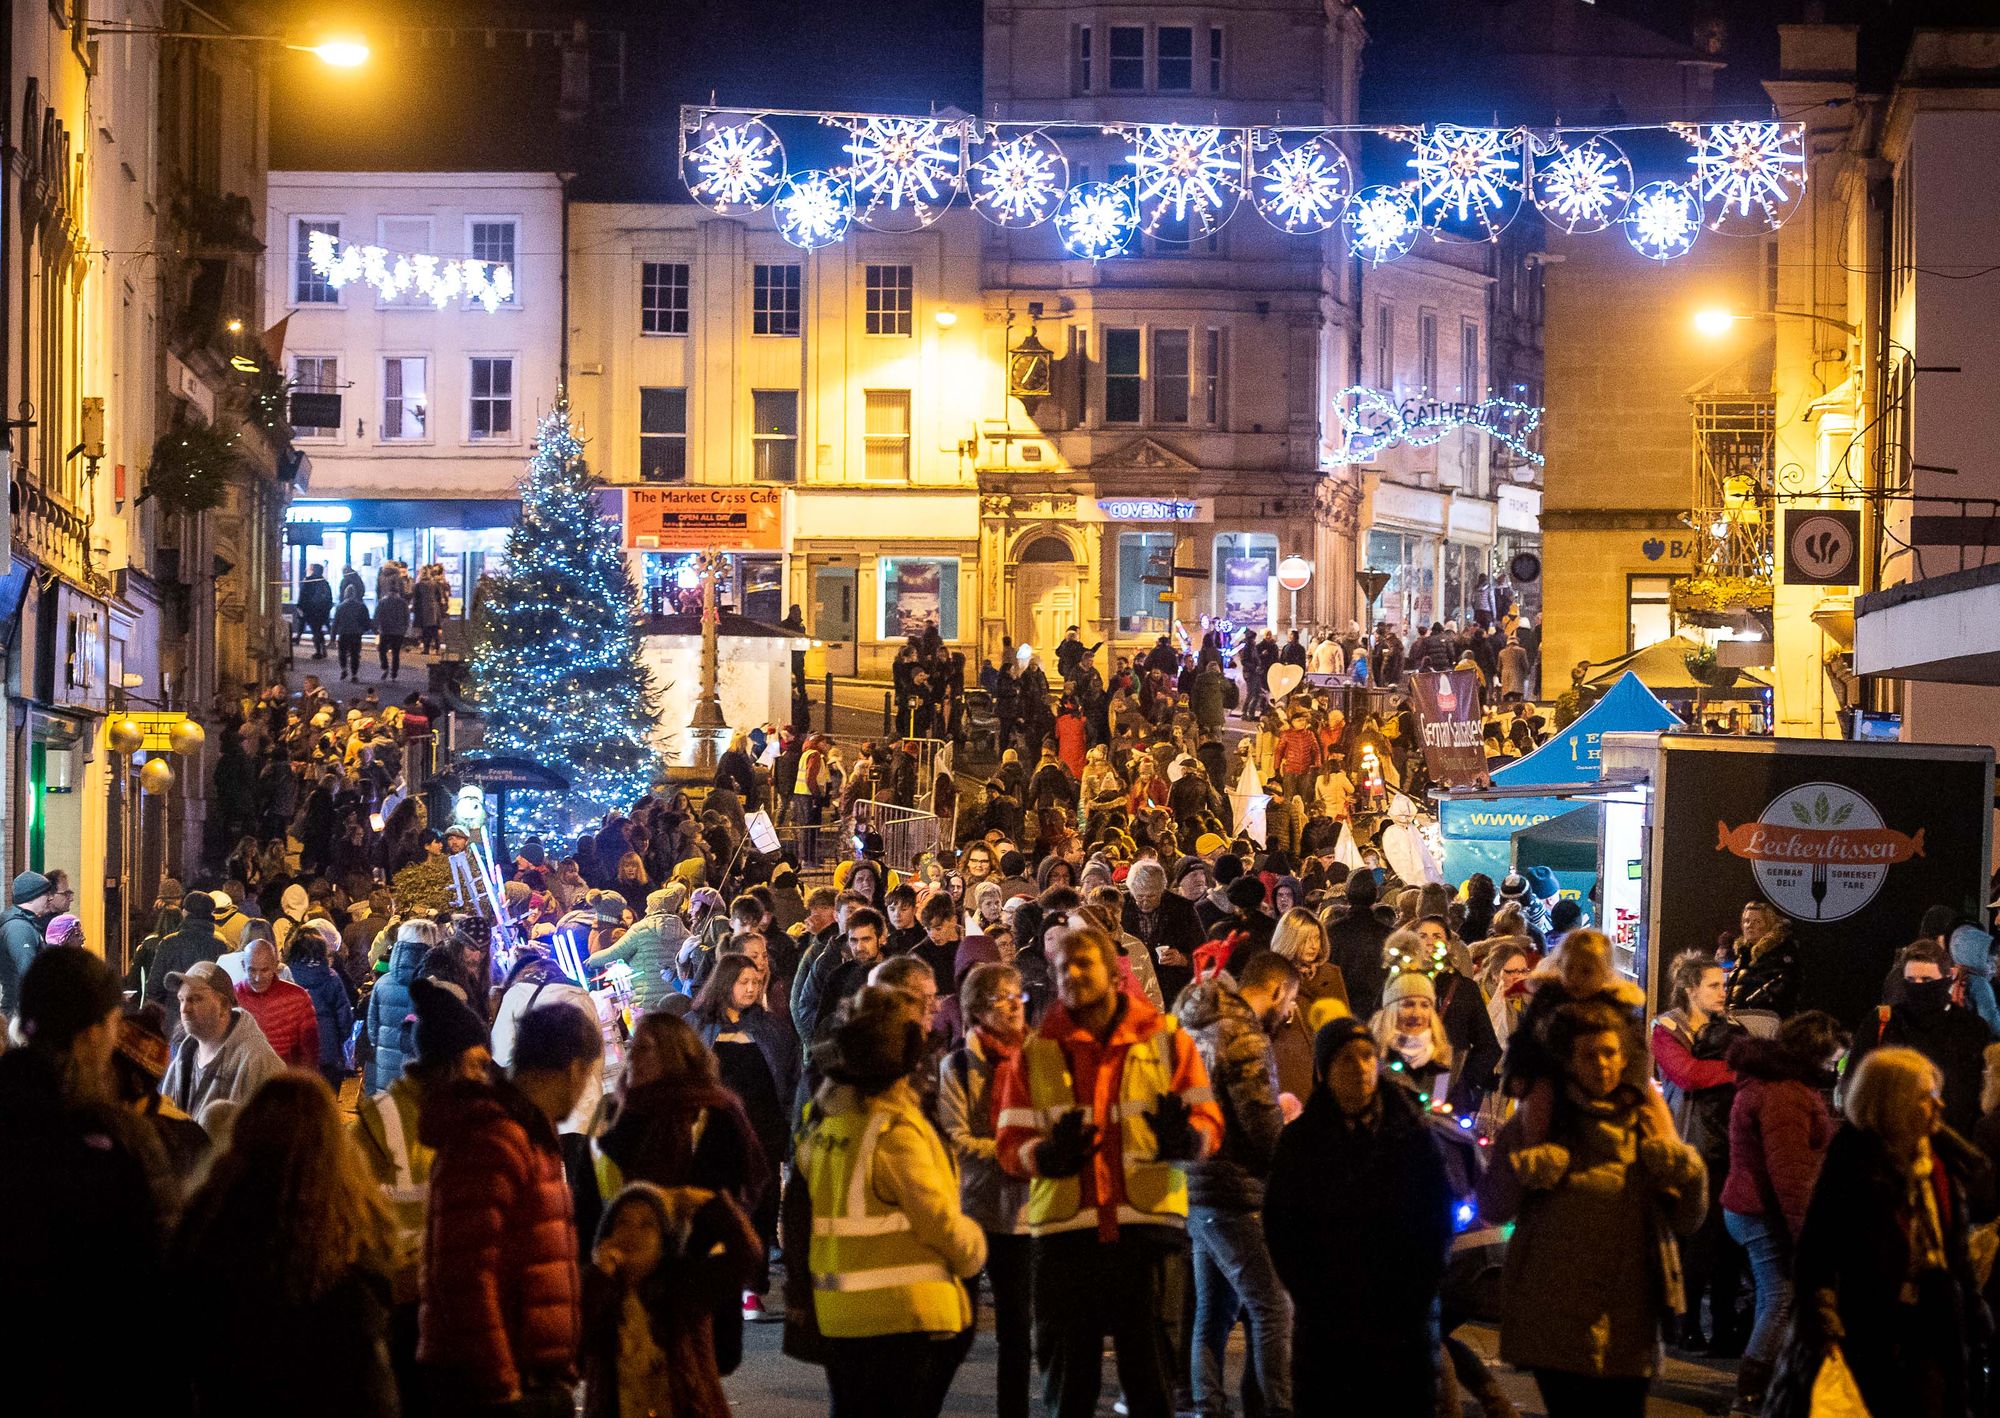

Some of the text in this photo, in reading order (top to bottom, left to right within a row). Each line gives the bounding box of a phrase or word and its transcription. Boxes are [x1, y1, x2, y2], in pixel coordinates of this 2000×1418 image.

[633, 489, 778, 503] The Market Cross Café
[1743, 830, 1897, 859] Leckerbissen
[1766, 868, 1877, 880] GERMAN SOMERSET
[1776, 878, 1865, 890] DELI FARE
